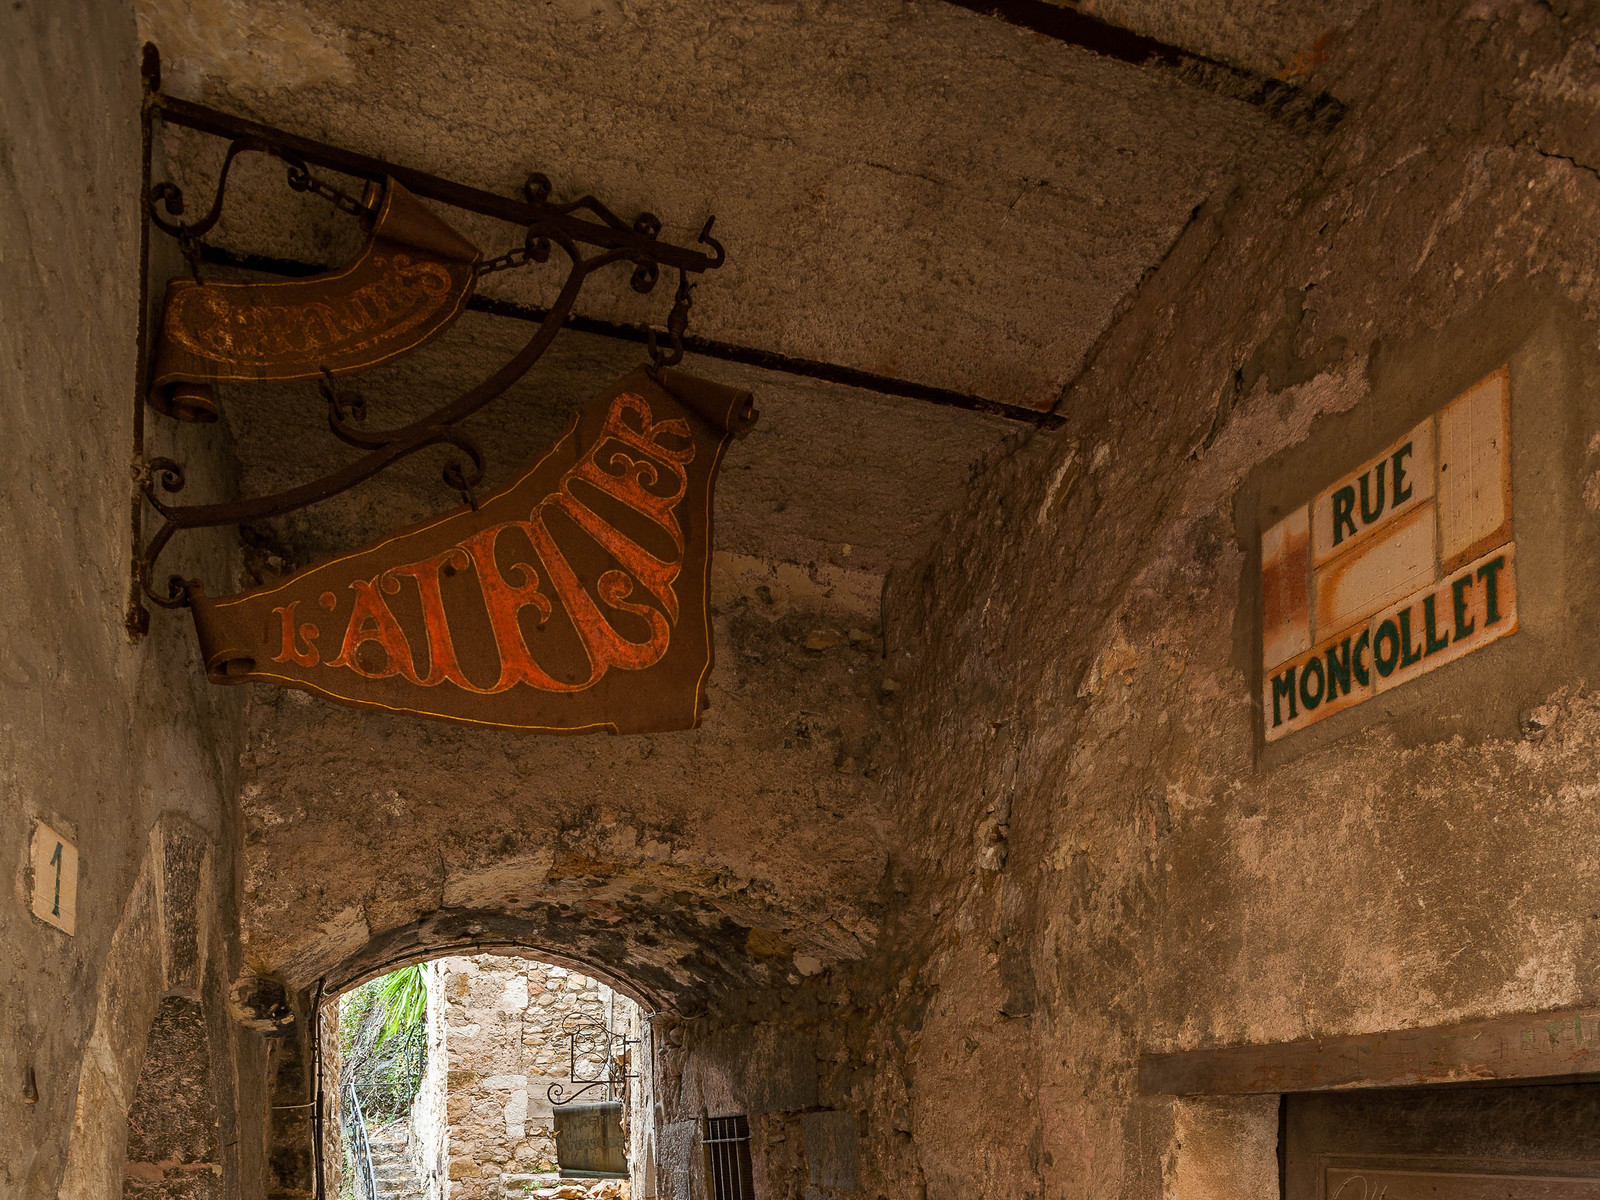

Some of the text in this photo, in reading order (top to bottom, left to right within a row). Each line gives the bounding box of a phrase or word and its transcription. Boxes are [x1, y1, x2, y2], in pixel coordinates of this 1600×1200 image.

[1331, 441, 1414, 548] RUE
[1269, 555, 1506, 728] MONCOLLET
[50, 840, 64, 919] 1
